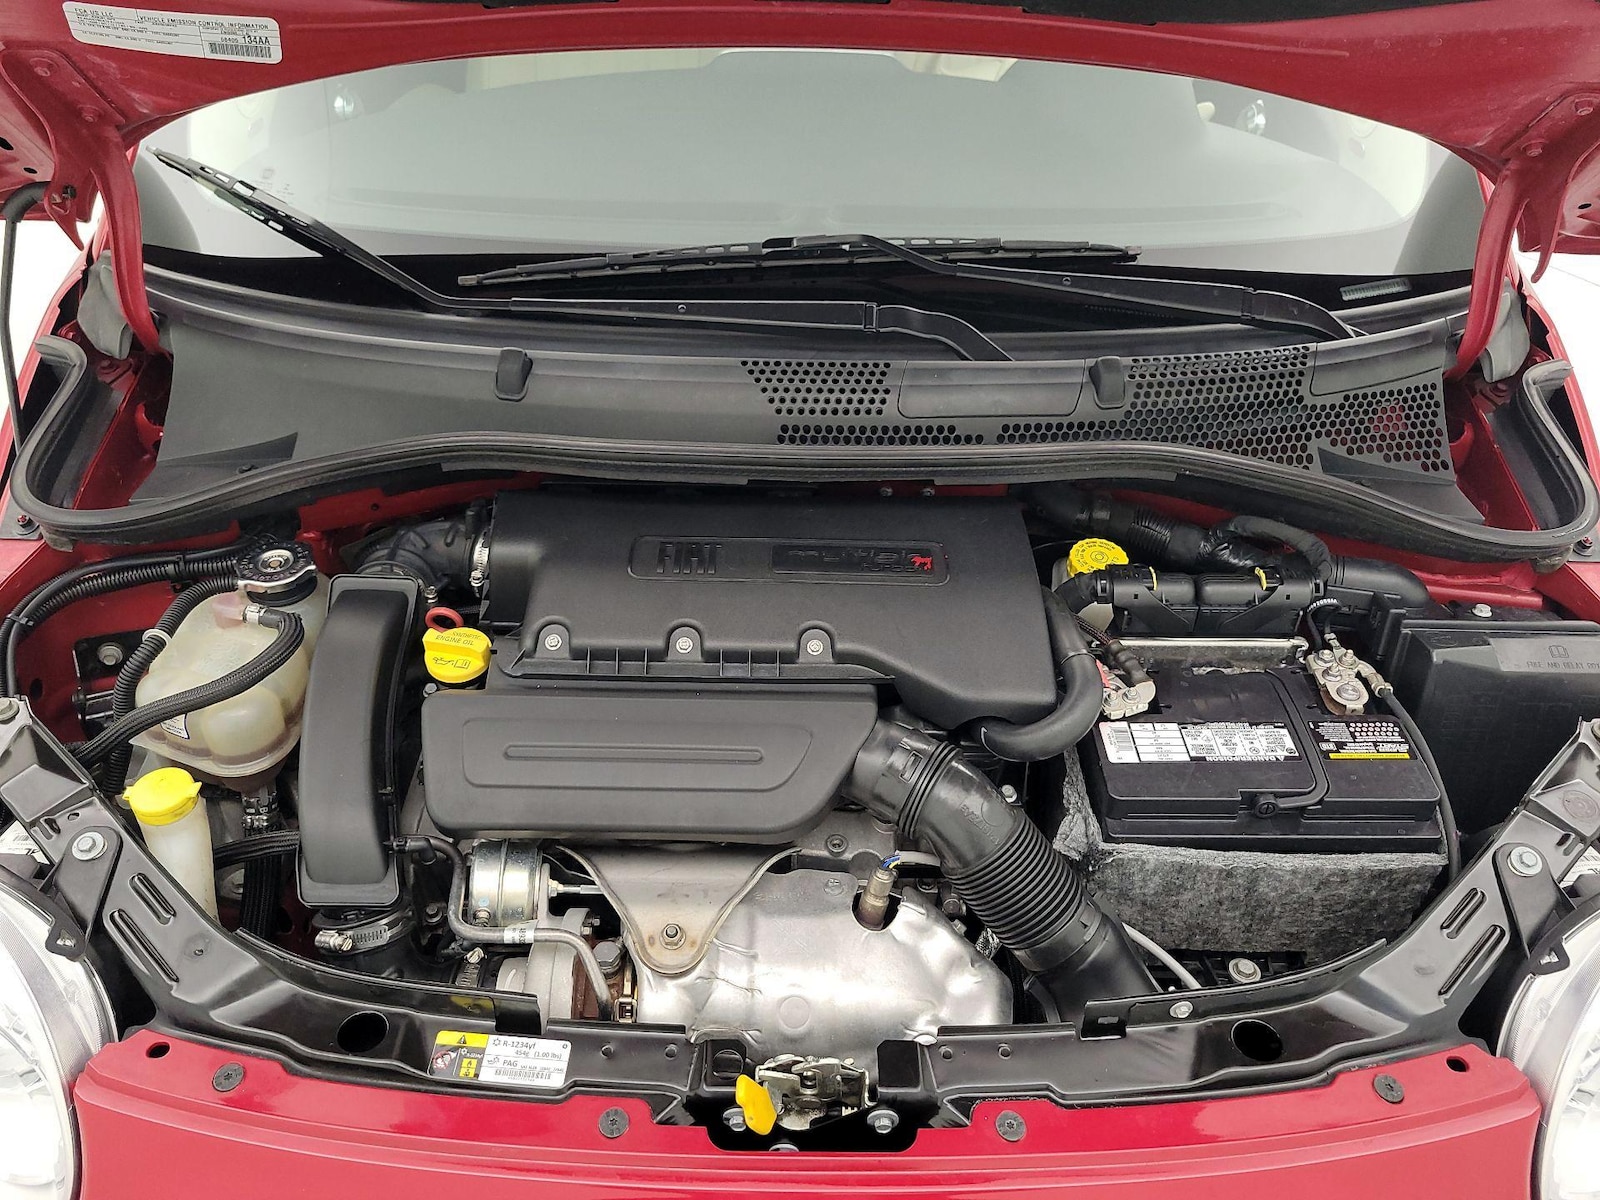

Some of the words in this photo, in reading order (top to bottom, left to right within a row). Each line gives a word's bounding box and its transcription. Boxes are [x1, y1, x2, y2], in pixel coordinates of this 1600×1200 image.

[166, 18, 196, 26] EMISSION
[198, 20, 225, 28] CONTROL
[227, 22, 269, 30] INFORMATION
[242, 35, 271, 45] 134AA
[656, 542, 723, 574] FIAT
[435, 635, 462, 644] ENGINE
[502, 1040, 536, 1050] R-1234yf
[502, 1059, 519, 1067] PAG
